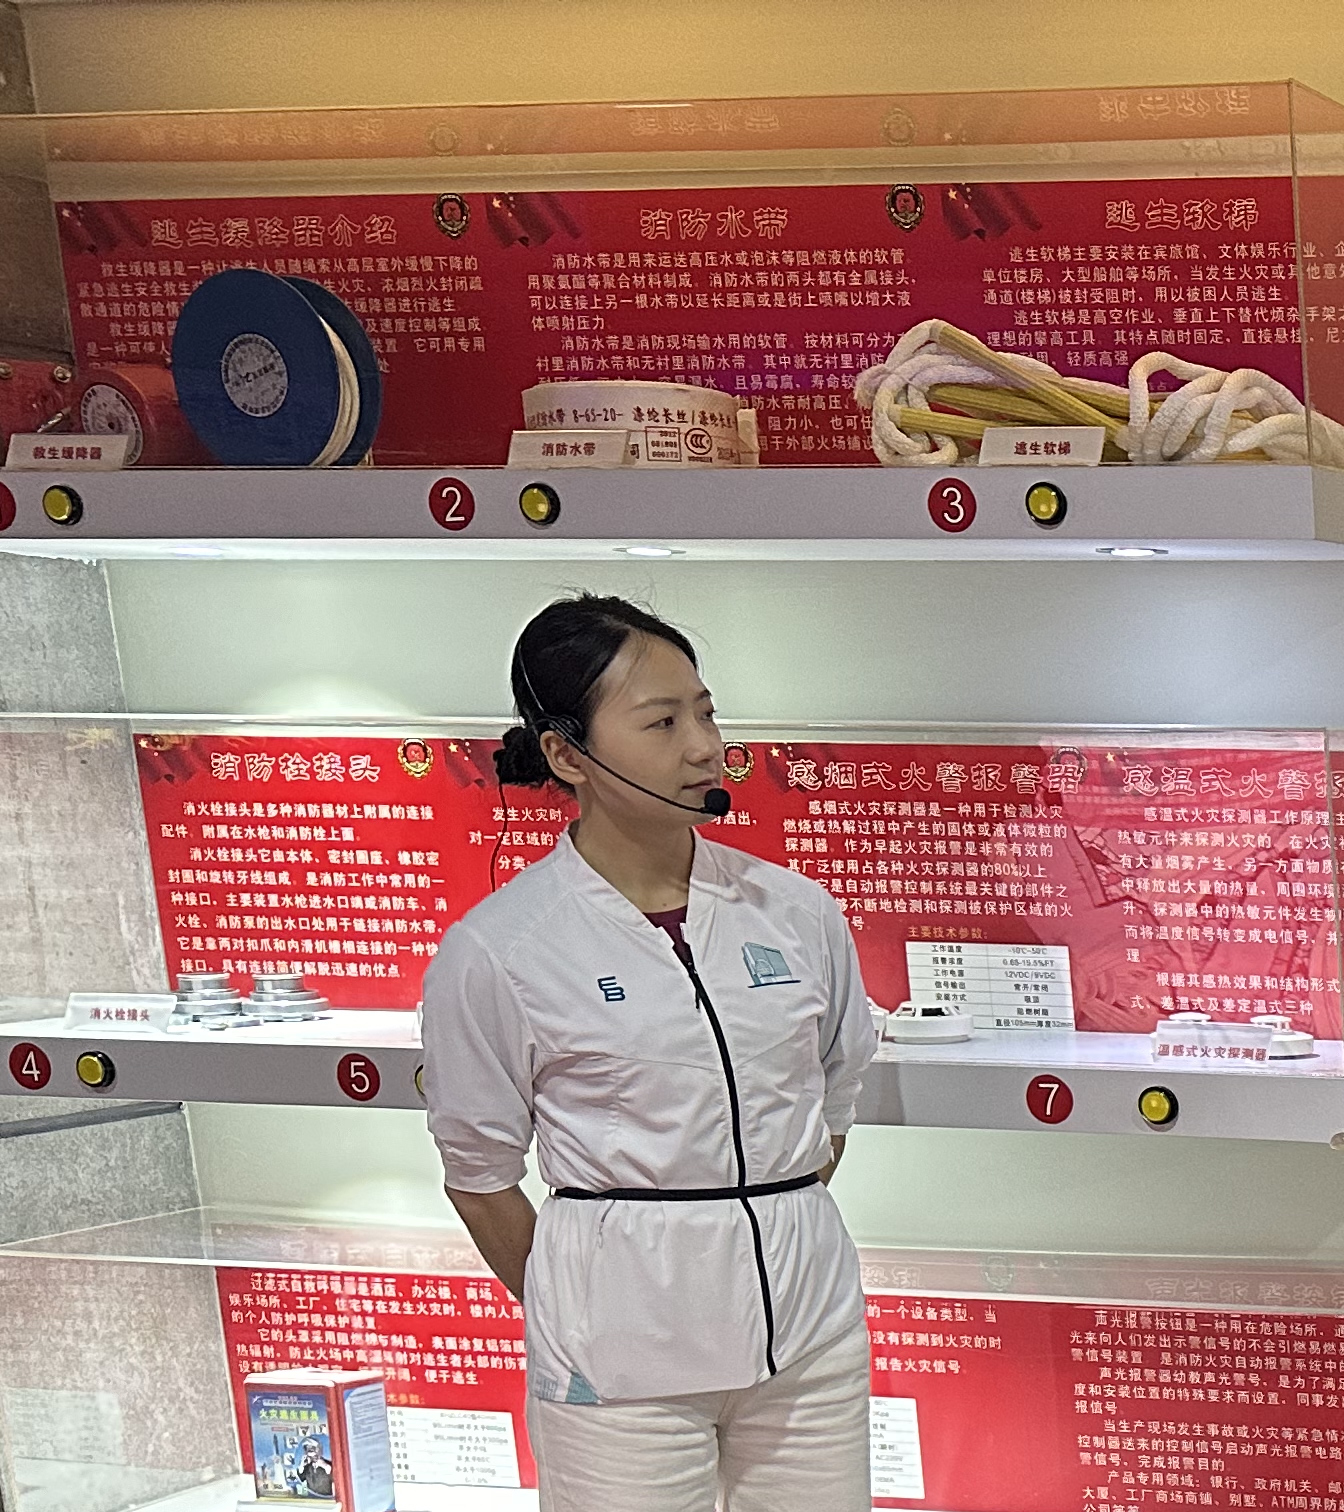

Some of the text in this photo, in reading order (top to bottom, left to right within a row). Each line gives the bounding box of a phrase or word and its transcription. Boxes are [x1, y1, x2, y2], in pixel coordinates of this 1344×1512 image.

[641, 206, 788, 240] 消防水带
[1105, 198, 1259, 231] 逃生软梯
[151, 215, 397, 247] 逃生缓降器介绍
[33, 446, 102, 460] 救生缓降器
[542, 443, 596, 456] 消防水带
[1014, 440, 1071, 457] 逃生软梯
[442, 486, 465, 522] 2
[942, 486, 964, 523] 3
[210, 752, 380, 783] 消防栓接头
[788, 759, 1081, 795] 感烟式火警报警器
[90, 1007, 151, 1021] 消火栓接头
[22, 1051, 39, 1082] 4
[351, 1063, 369, 1093] 5
[1038, 1083, 1060, 1115] 7
